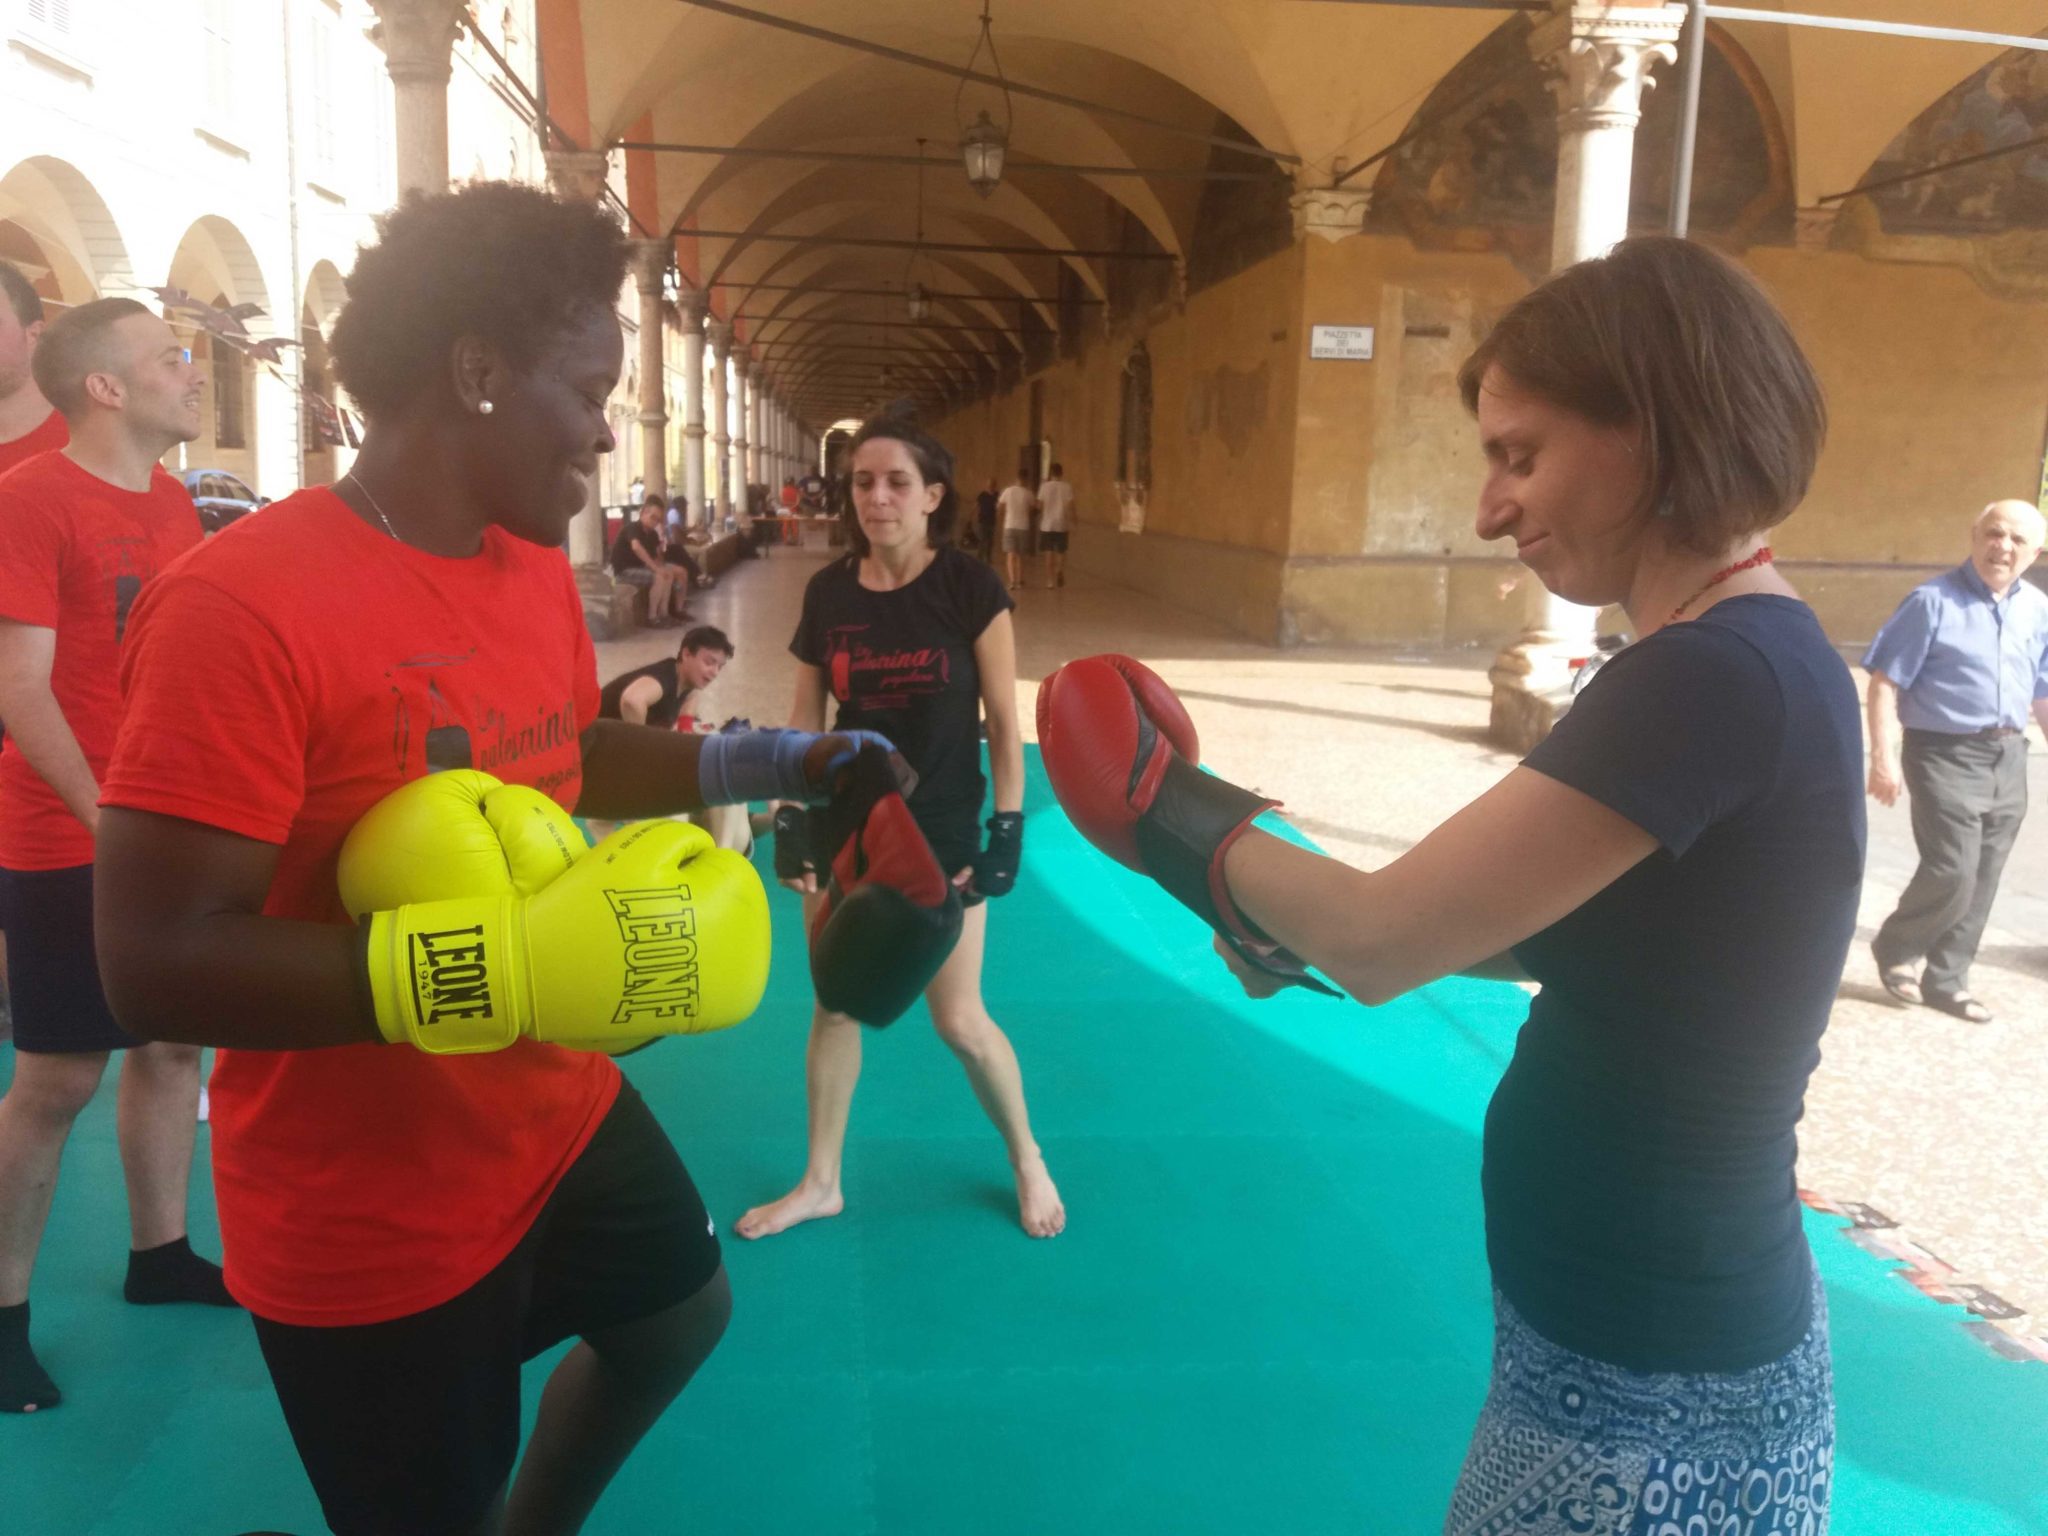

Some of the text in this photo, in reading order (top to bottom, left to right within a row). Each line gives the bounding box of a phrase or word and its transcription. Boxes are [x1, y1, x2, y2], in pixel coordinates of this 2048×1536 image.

[1323, 330, 1362, 339] PIAZZETTA
[1336, 339, 1349, 347] DEI
[1314, 347, 1336, 355] SERVI
[1346, 348, 1369, 356] MARIA
[602, 884, 700, 1025] LEONE
[417, 924, 493, 1025] LEONE
[418, 960, 432, 1000] 1947
